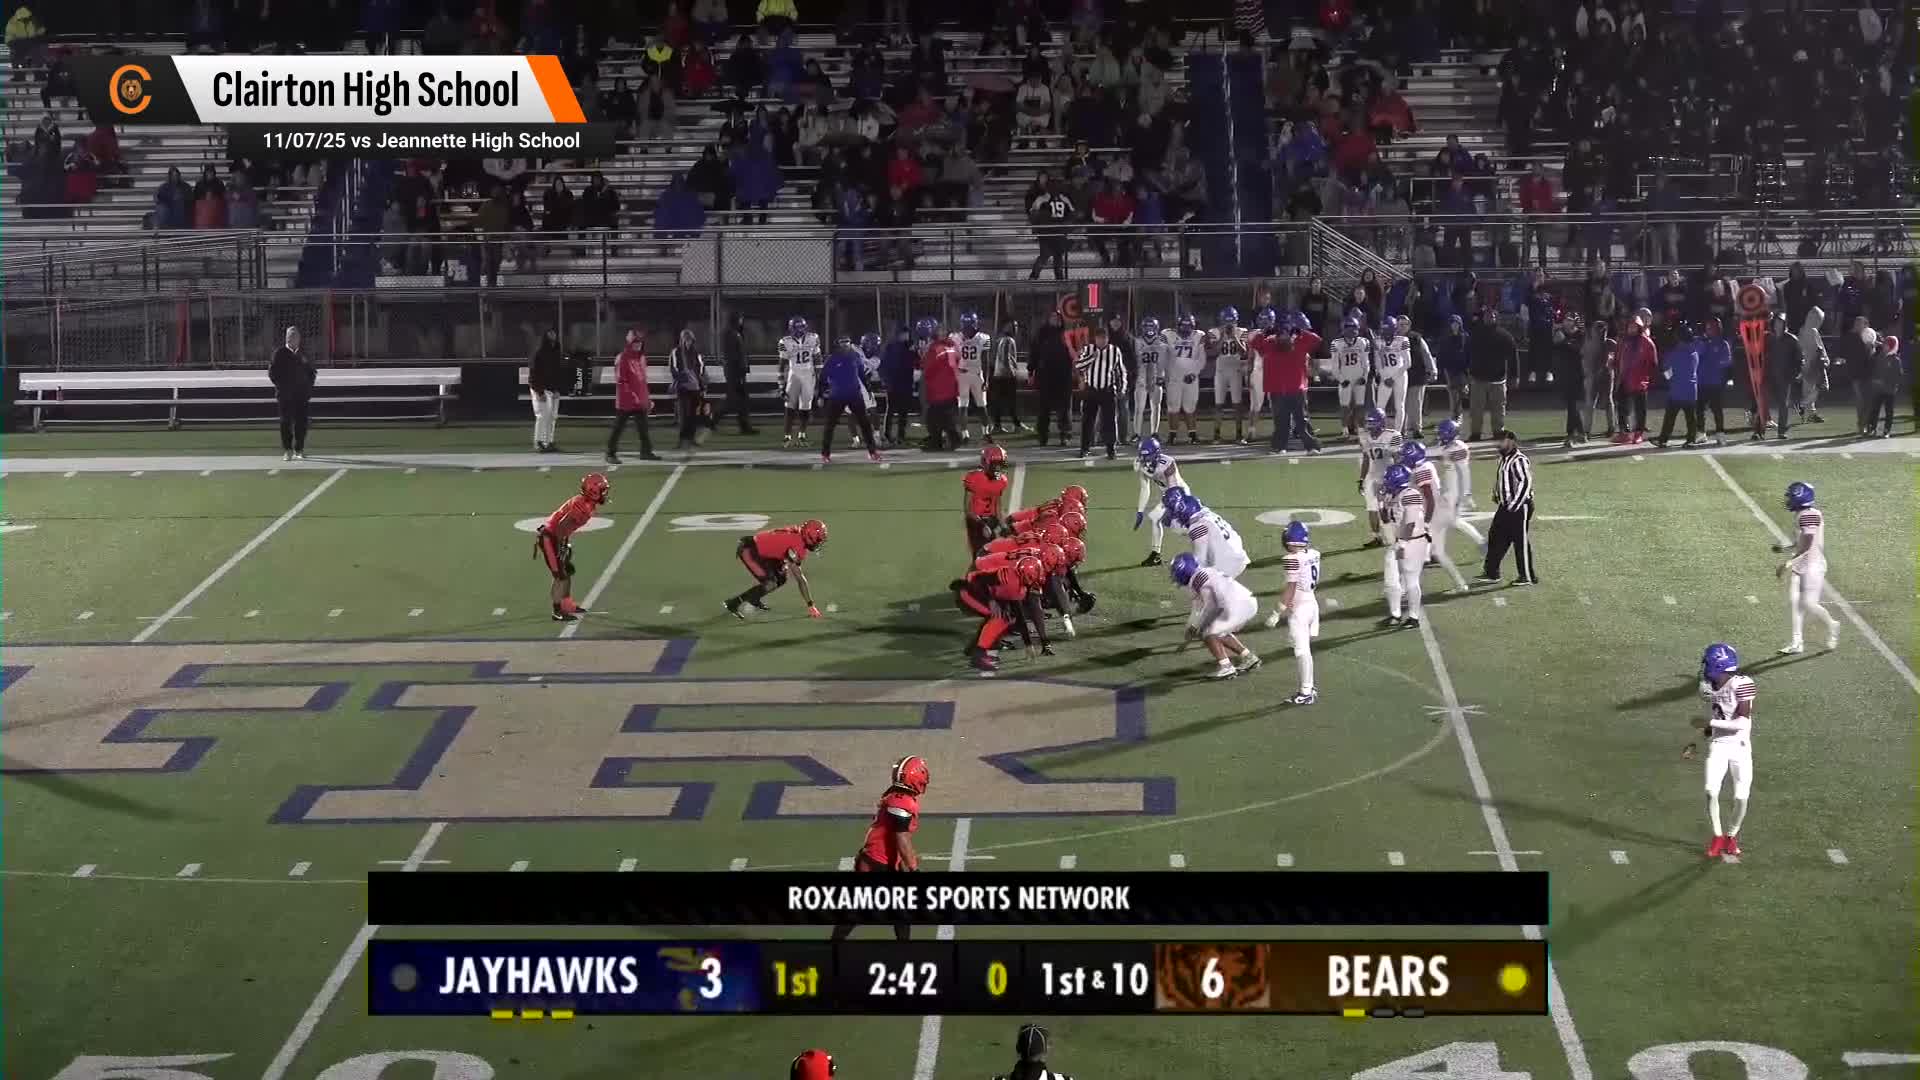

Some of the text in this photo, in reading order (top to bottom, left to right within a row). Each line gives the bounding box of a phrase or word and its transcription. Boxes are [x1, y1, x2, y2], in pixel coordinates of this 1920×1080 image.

[1050, 201, 1065, 218] 19
[1087, 283, 1098, 308] 1
[961, 346, 977, 360] 62
[1175, 345, 1193, 359] 77
[1345, 353, 1358, 366] 15
[1383, 353, 1397, 367] 16
